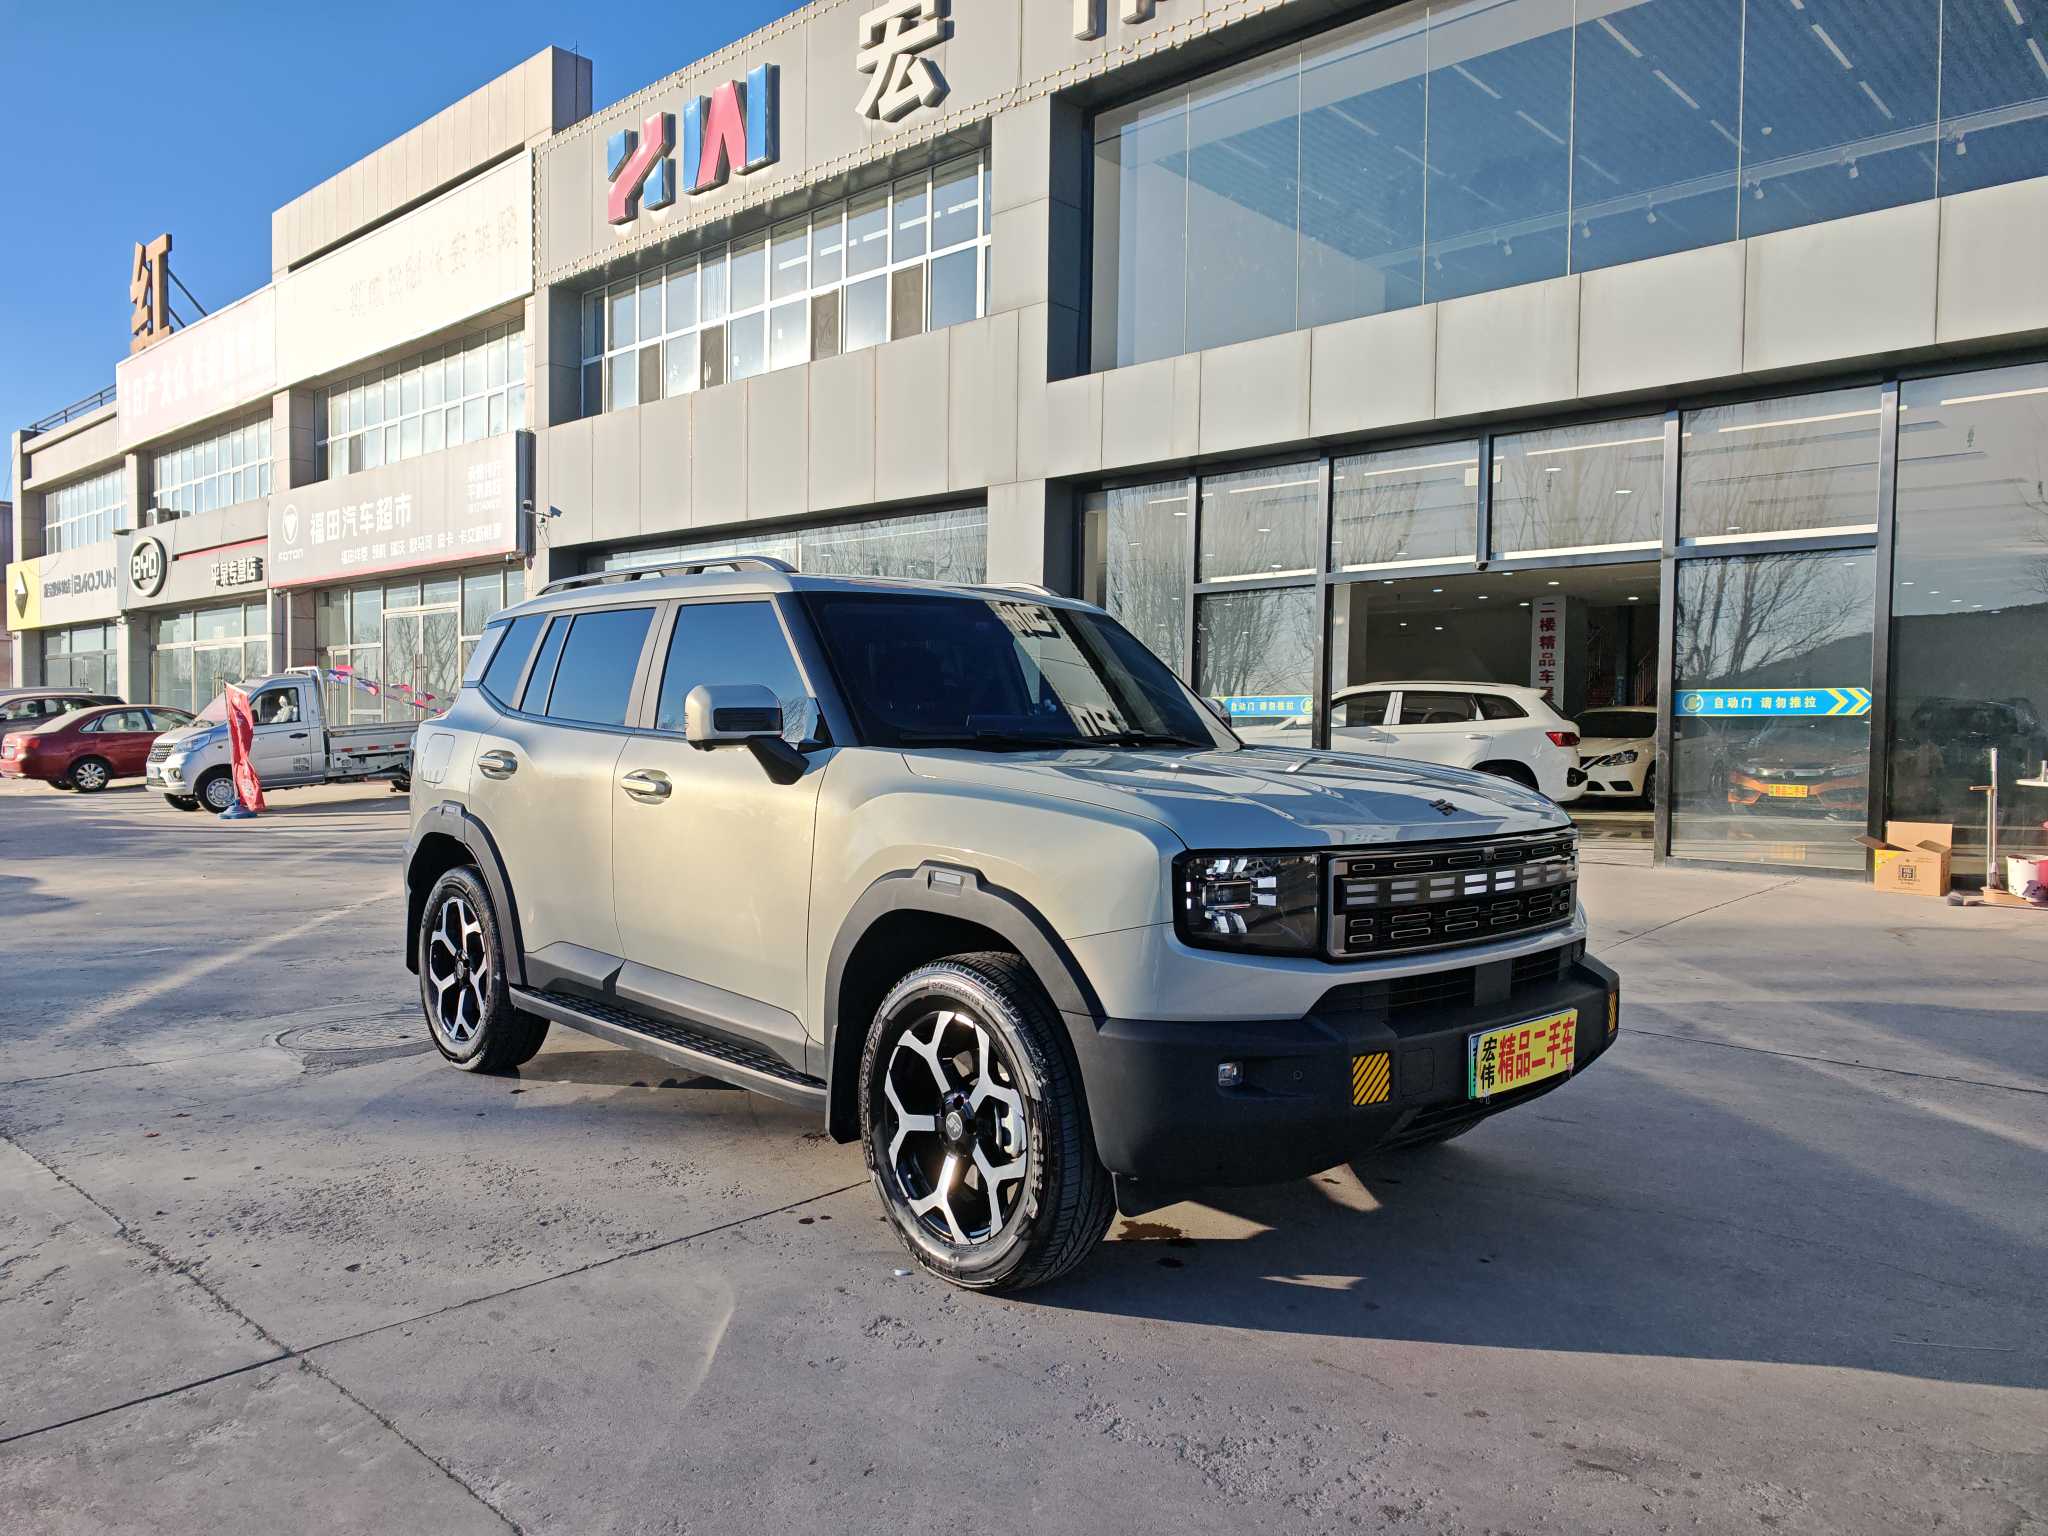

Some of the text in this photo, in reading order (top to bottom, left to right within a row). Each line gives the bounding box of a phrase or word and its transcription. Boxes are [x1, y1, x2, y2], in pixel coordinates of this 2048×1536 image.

[854, 0, 953, 122] 宏
[310, 492, 412, 545] 福田汽车超市
[133, 552, 159, 580] BYD
[278, 548, 304, 562] FOTON
[74, 566, 117, 595] BAOJUN
[210, 556, 260, 586] 平泉专营店
[1713, 695, 1817, 709] 自动门 请勿推拉
[1480, 1036, 1498, 1090] 宏伟
[1498, 1016, 1575, 1085] 精品二手车
